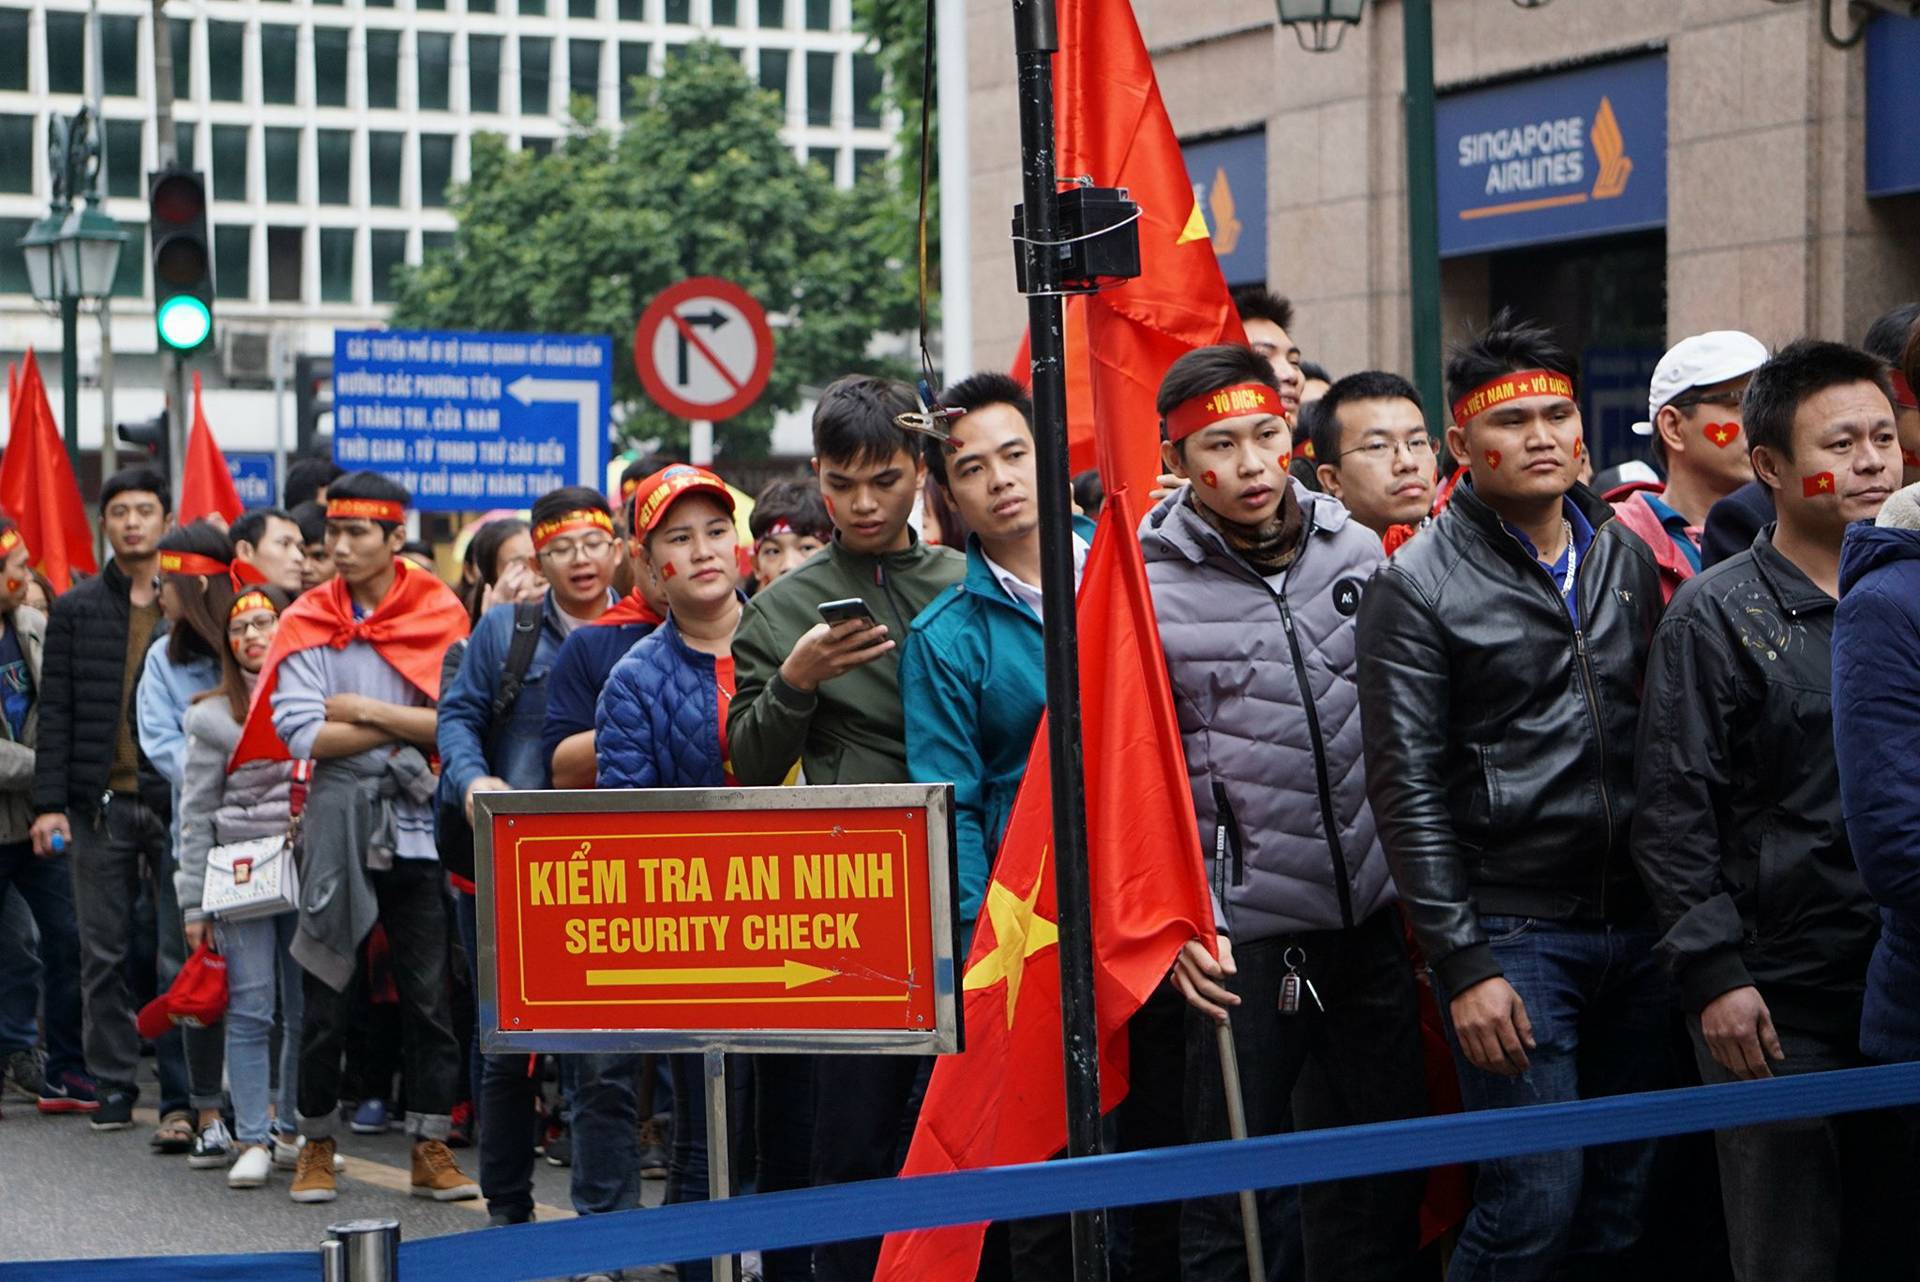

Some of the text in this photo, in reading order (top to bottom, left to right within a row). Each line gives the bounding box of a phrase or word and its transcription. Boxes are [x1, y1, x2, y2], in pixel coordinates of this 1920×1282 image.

[1459, 116, 1583, 166] SINGAPORE
[1485, 151, 1583, 195] AIRLINES
[1213, 390, 1230, 414] VÔ
[1487, 382, 1515, 403] NAM
[1531, 375, 1547, 393] VÔ
[465, 408, 500, 431] NAM
[529, 842, 894, 905] KIỂM TRA AN NINH
[565, 912, 861, 954] SECURITY CHECK
